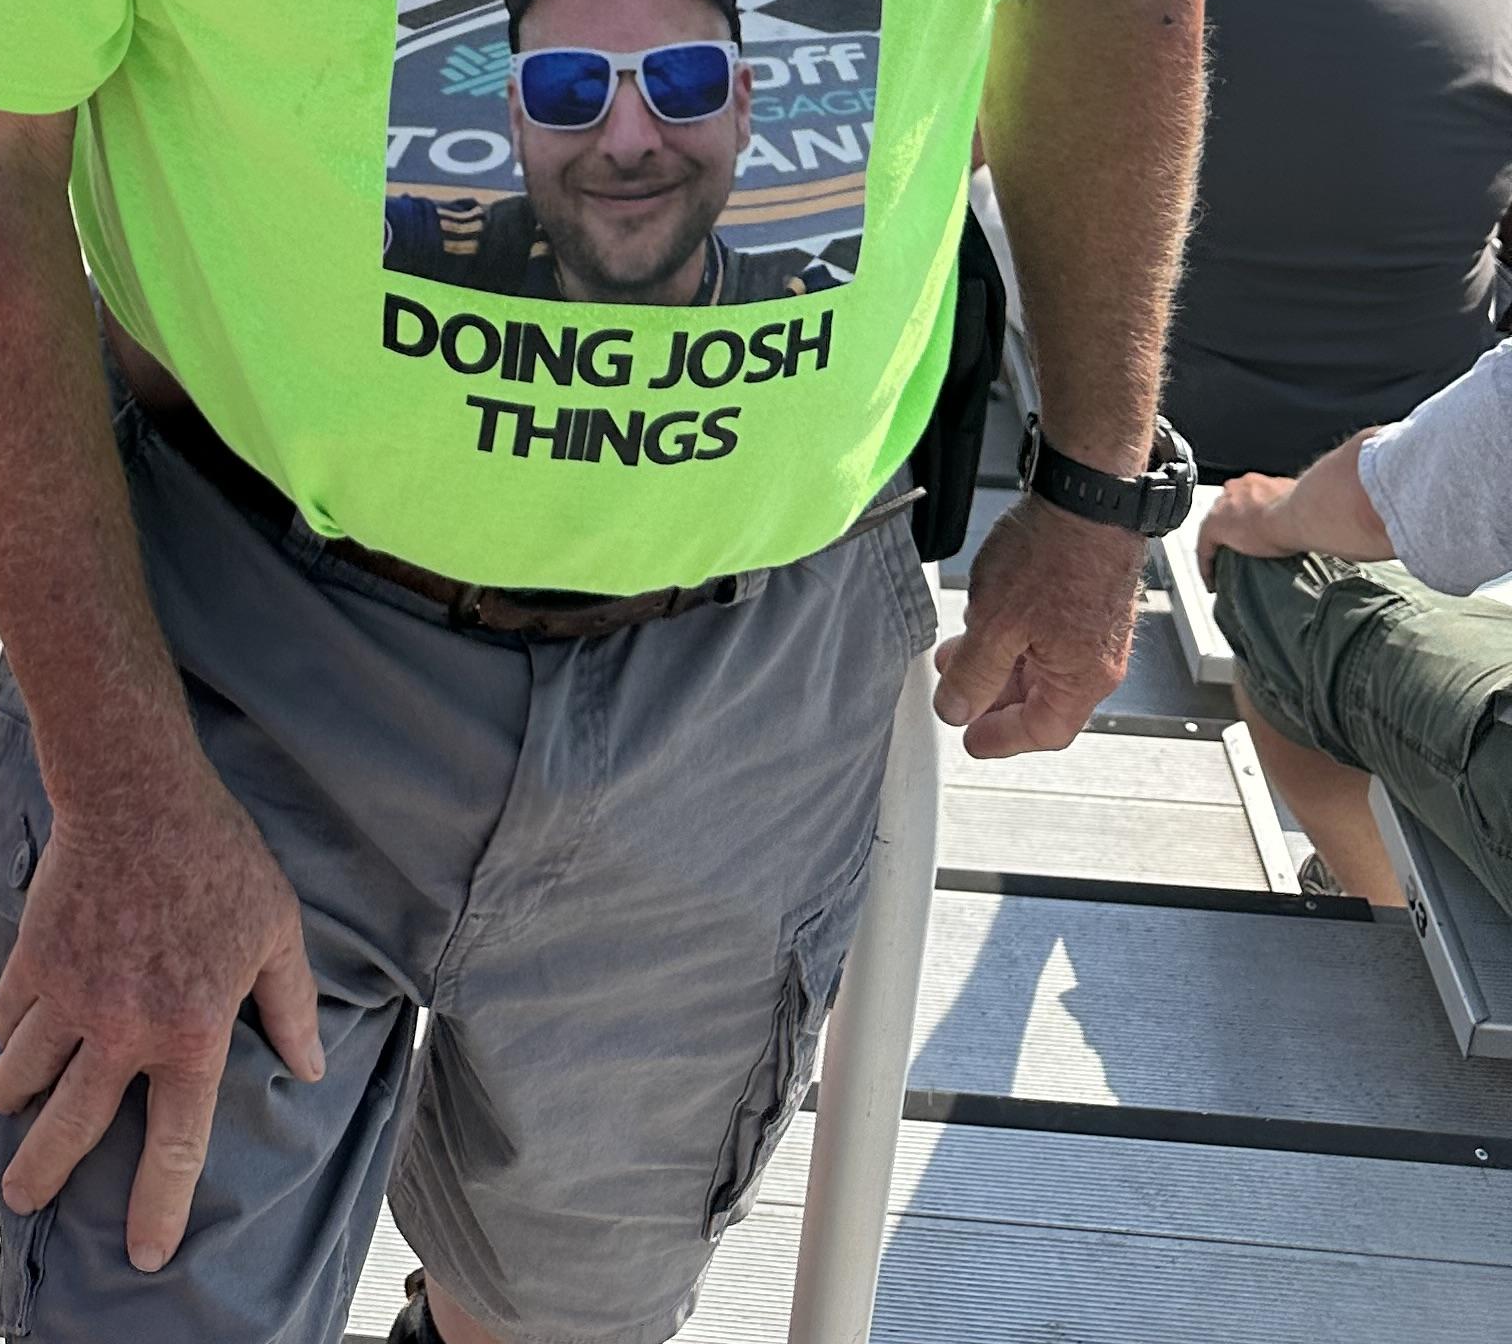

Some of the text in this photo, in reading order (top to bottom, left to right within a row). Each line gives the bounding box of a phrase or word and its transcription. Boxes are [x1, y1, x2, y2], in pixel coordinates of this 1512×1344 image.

[384, 126, 526, 179] TO
[382, 292, 834, 389] DOING JOSH
[466, 394, 742, 467] THINGS
